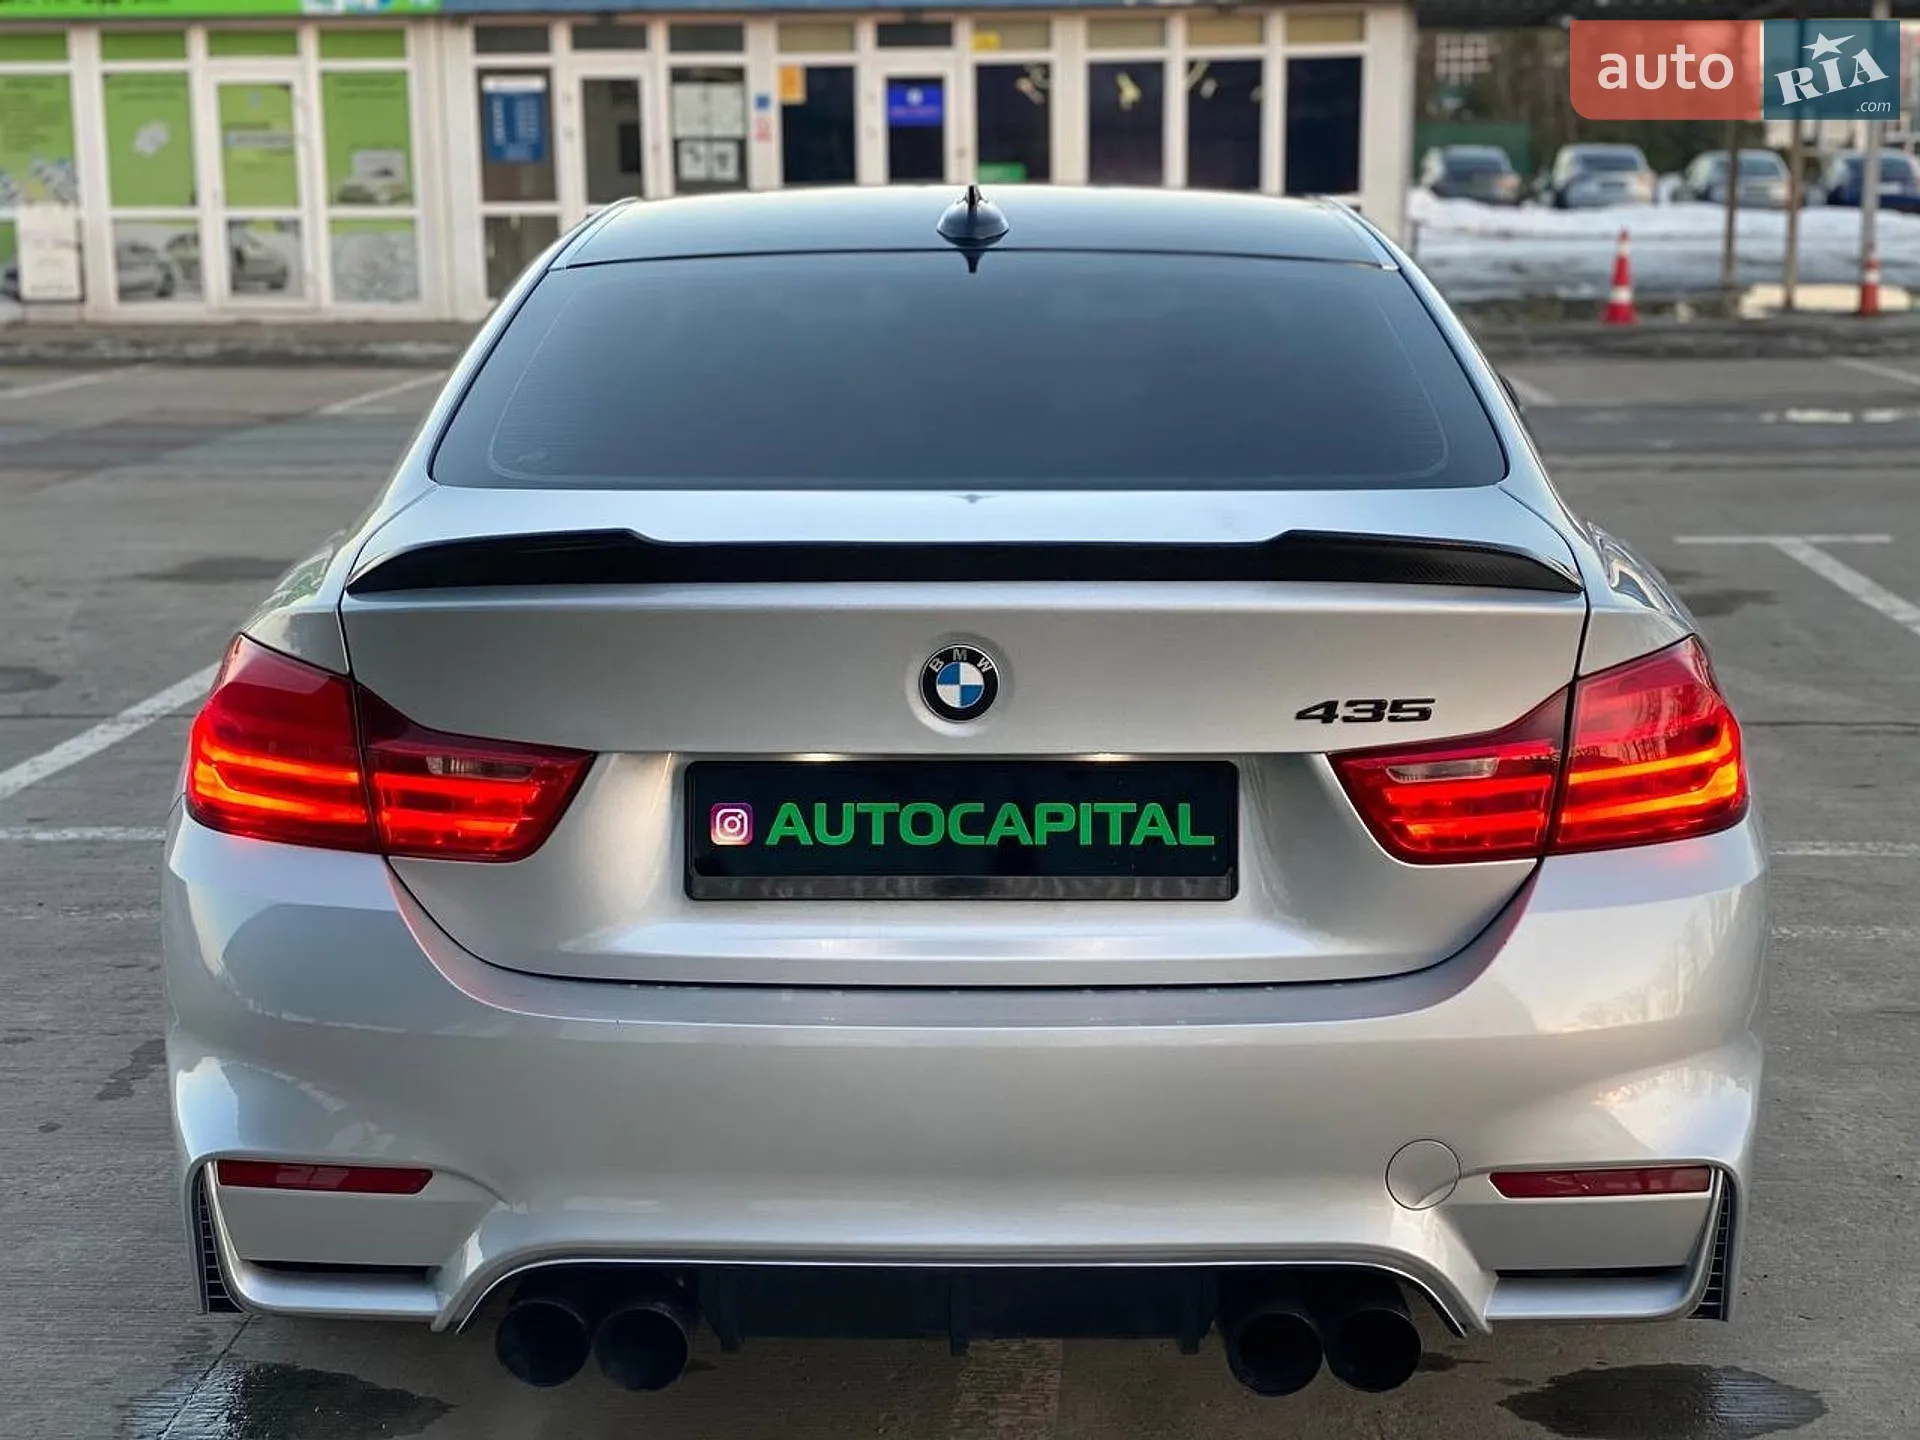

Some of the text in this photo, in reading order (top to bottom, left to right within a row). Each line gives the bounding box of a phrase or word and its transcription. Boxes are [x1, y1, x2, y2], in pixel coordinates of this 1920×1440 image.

[928, 647, 993, 673] BMW
[1295, 698, 1436, 724] 435
[765, 802, 1215, 846] AUTOCAPITAL
